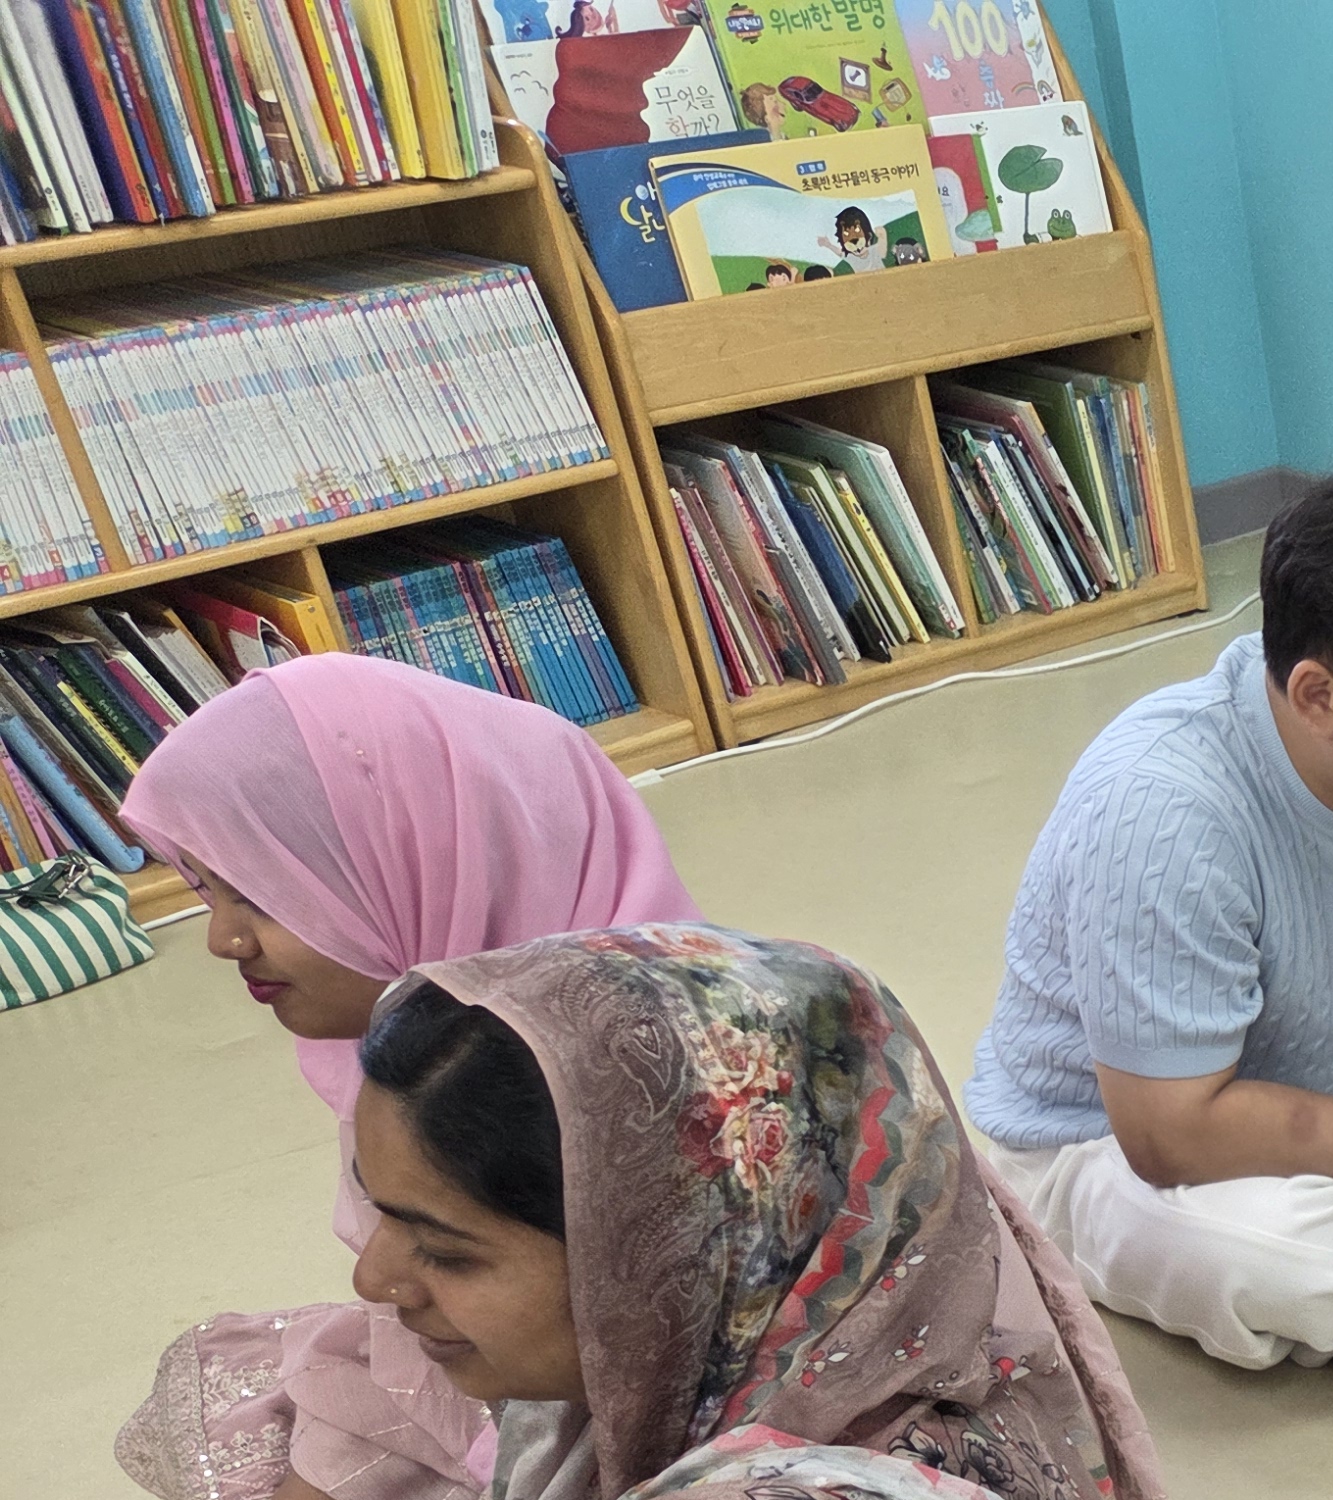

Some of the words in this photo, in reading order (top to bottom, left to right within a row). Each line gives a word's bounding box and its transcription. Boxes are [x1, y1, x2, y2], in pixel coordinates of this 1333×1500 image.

[769, 3, 834, 35] 위대한
[831, 0, 886, 32] 발명
[928, 0, 1011, 62] 100
[654, 84, 716, 115] 무엇을
[801, 175, 832, 192] 초록반
[831, 169, 871, 189] 친구들의
[891, 163, 920, 181] 이야기
